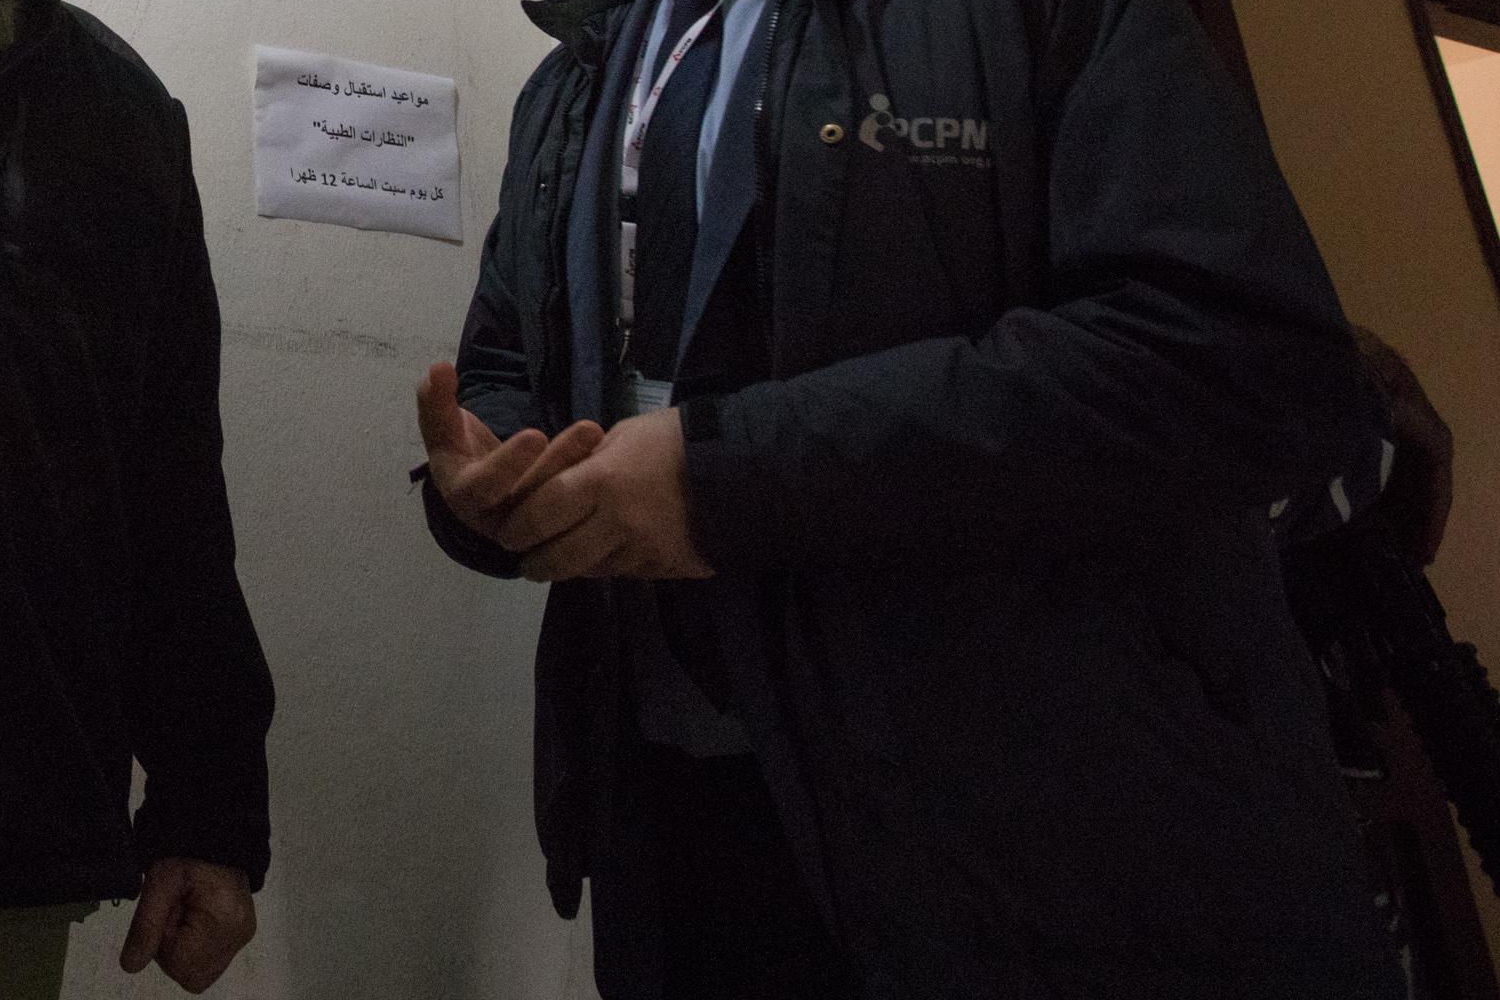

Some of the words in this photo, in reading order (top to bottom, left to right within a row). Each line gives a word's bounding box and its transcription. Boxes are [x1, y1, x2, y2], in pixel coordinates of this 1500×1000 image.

[297, 73, 340, 96] وصفات
[344, 80, 387, 100] استقبال
[391, 89, 429, 108] مواعيد
[320, 173, 338, 188] 12
[341, 172, 377, 191] الساعة
[381, 180, 406, 197] سبت
[409, 187, 427, 202] يوم
[430, 186, 444, 201] كل
